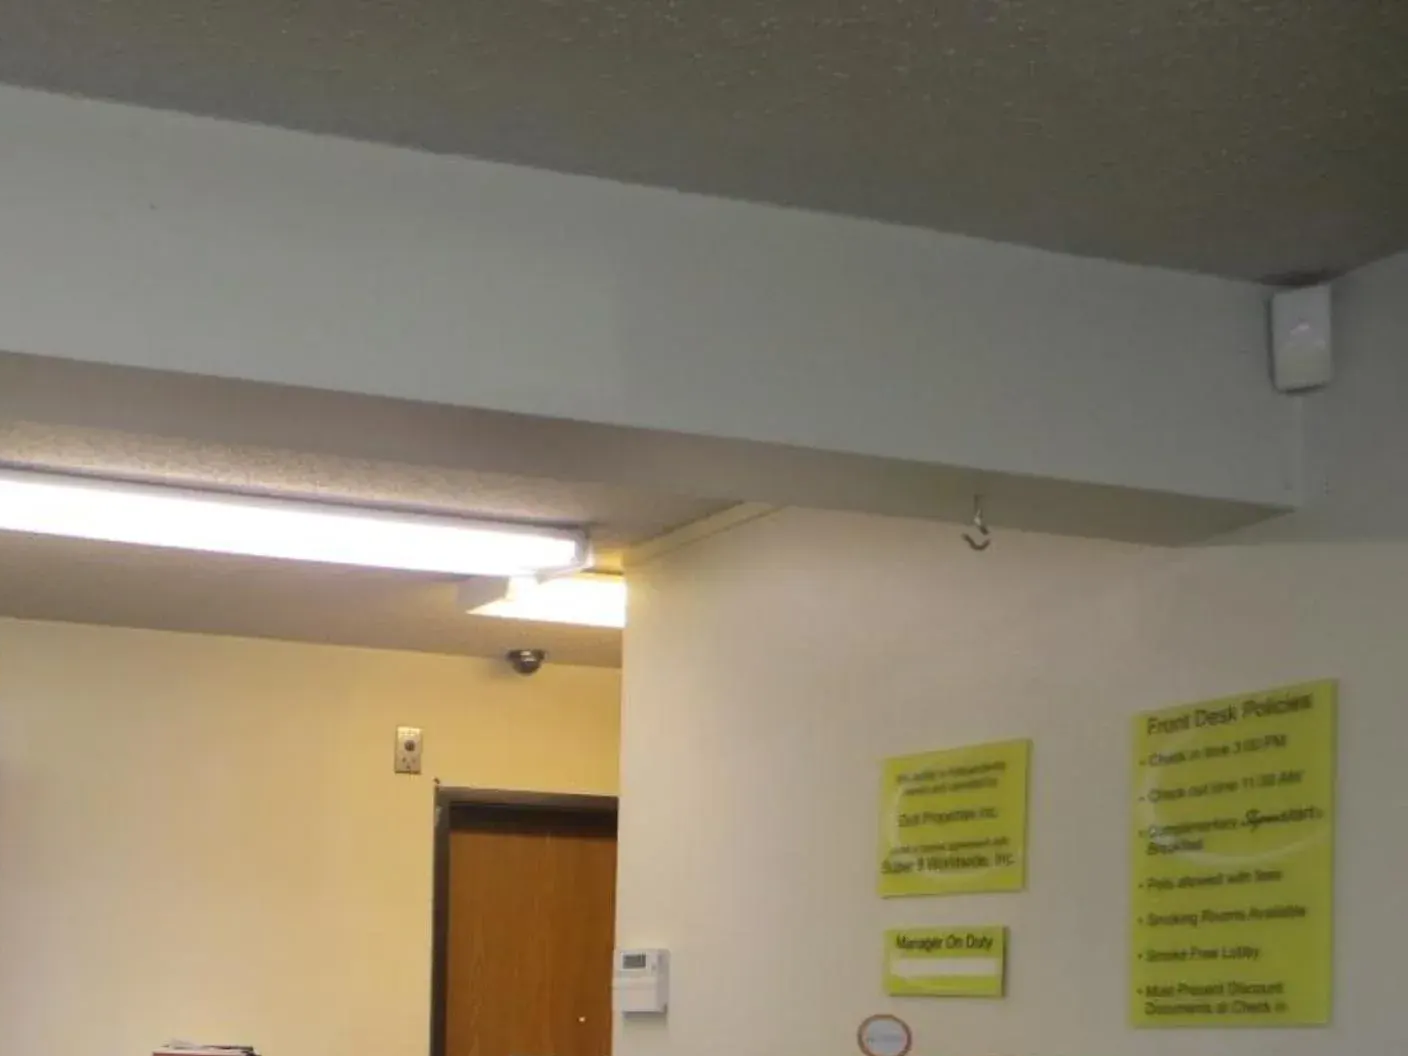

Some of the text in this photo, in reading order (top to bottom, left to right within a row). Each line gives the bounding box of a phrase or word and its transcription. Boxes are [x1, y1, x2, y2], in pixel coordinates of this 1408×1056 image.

[1147, 715, 1190, 735] Front
[1194, 704, 1237, 728] Desk
[1147, 912, 1198, 928] Smoking
[1201, 908, 1246, 923] Rooms
[896, 932, 994, 953] Manager On Duty
[1221, 945, 1260, 961] Lobby
[1227, 979, 1284, 995] Discount
[1231, 999, 1272, 1015] Check
